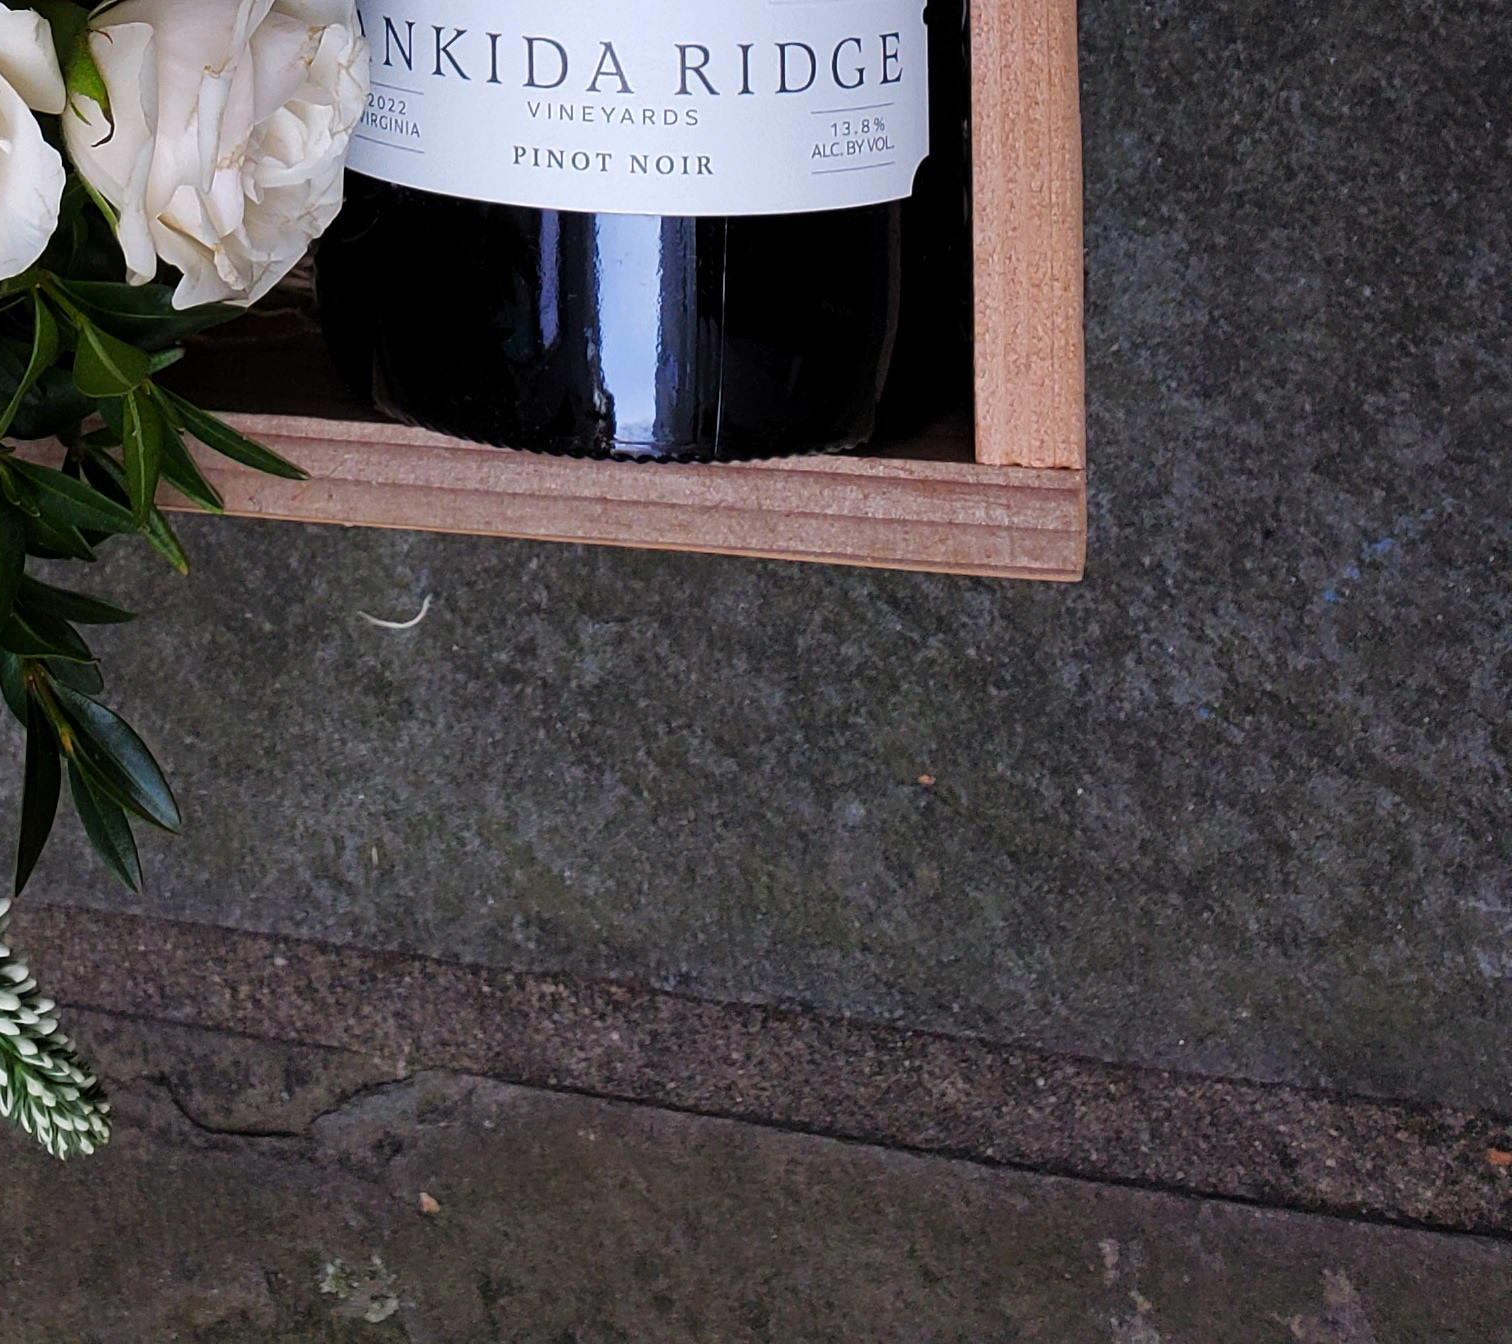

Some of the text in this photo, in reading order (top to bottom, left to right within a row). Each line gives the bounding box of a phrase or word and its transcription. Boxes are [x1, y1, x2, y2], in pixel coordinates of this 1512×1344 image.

[356, 9, 904, 96] NKIDA RIDGE
[367, 92, 407, 116] 2022
[526, 100, 700, 126] VINEYARDS
[830, 116, 886, 137] 13.8%
[511, 145, 715, 176] PINOT NOIR
[811, 142, 844, 159] ALC.
[846, 138, 865, 156] BY
